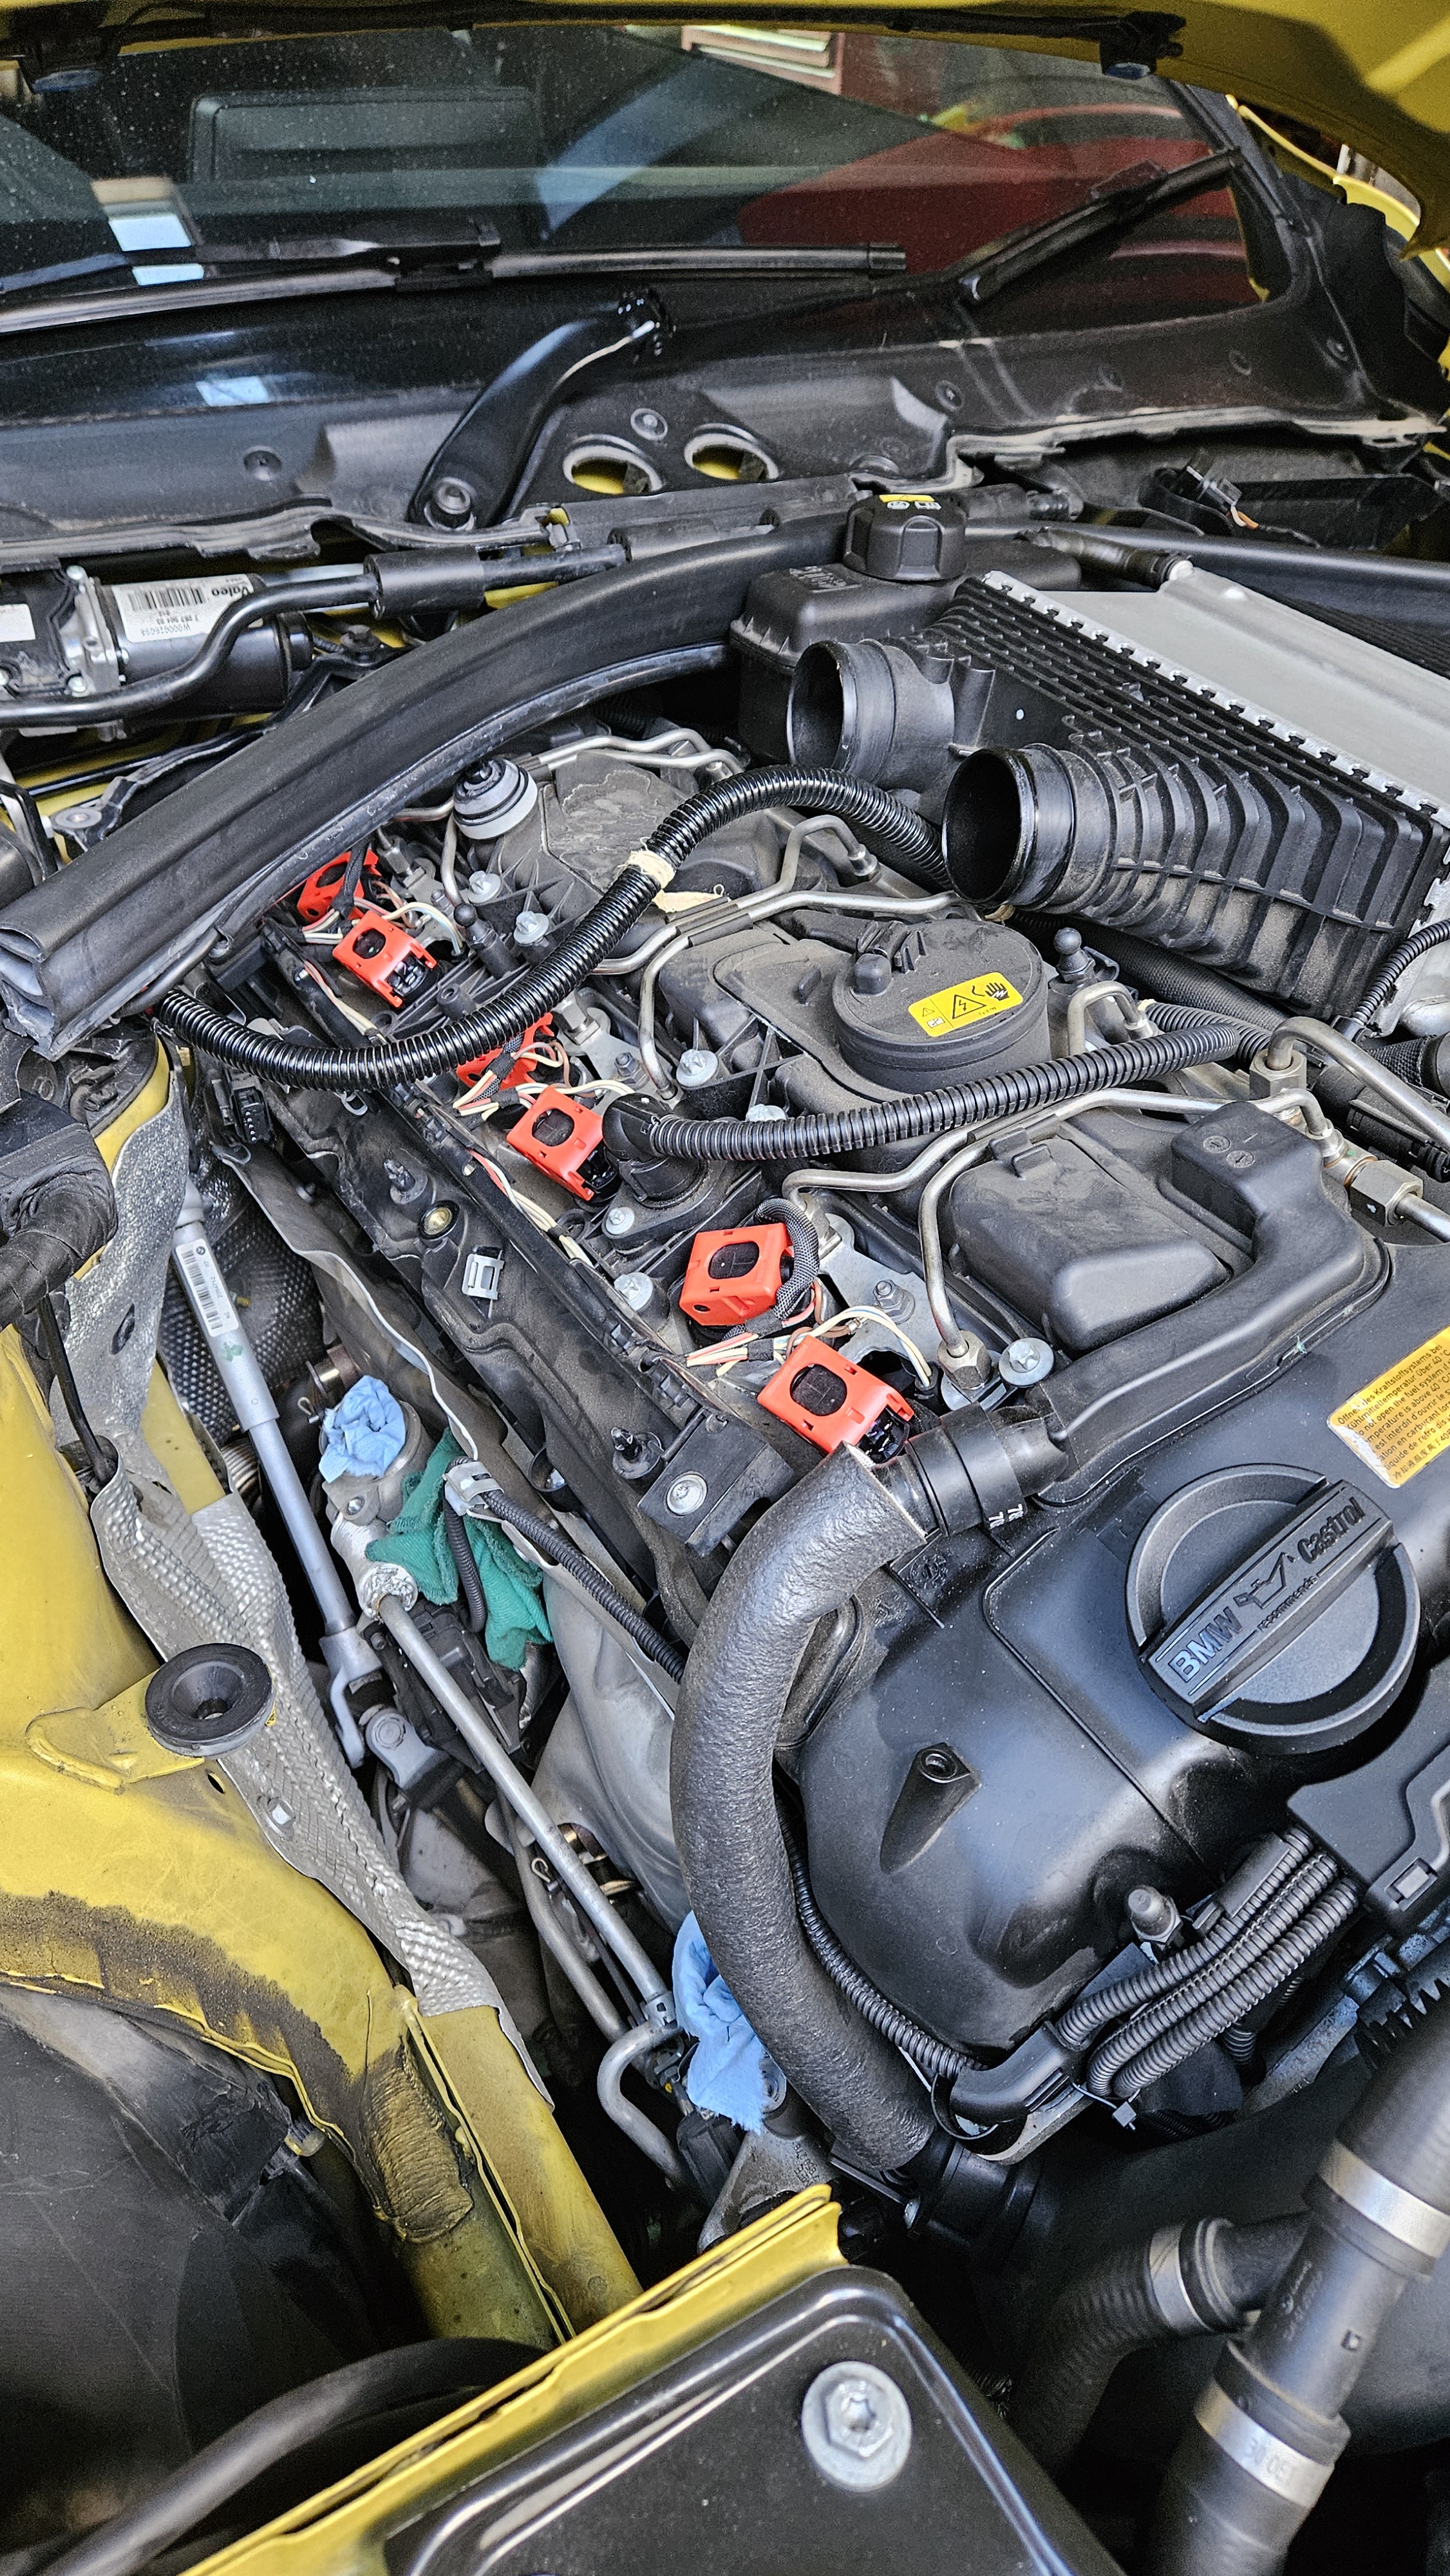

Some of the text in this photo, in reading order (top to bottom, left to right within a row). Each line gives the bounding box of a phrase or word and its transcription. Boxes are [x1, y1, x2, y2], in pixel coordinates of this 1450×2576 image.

[212, 585, 249, 598] Valeo
[1417, 1363, 1433, 1377] über
[1432, 1356, 1442, 1365] 40
[1337, 1404, 1362, 1425] Öffnen
[1362, 1394, 1375, 1406] des
[1373, 1352, 1432, 1396] Kraftstoffsystems
[1429, 1344, 1443, 1354] bei
[1364, 1419, 1377, 1431] not
[1376, 1406, 1395, 1421] open
[1393, 1397, 1406, 1407] the
[1404, 1385, 1420, 1398] fuel
[1418, 1368, 1444, 1388] system
[1442, 1362, 1449, 1370] if
[1411, 1390, 1431, 1408] above
[1430, 1383, 1440, 1392] 40
[1375, 1438, 1387, 1450] est
[1384, 1419, 1413, 1441] interdit
[1397, 1437, 1408, 1446] en
[1406, 1410, 1441, 1438] carburant
[1384, 1449, 1409, 1470] liquide
[1408, 1441, 1418, 1450] de
[1168, 1497, 1366, 1683] BMW Castrol
[1257, 1575, 1319, 1631] recommends
